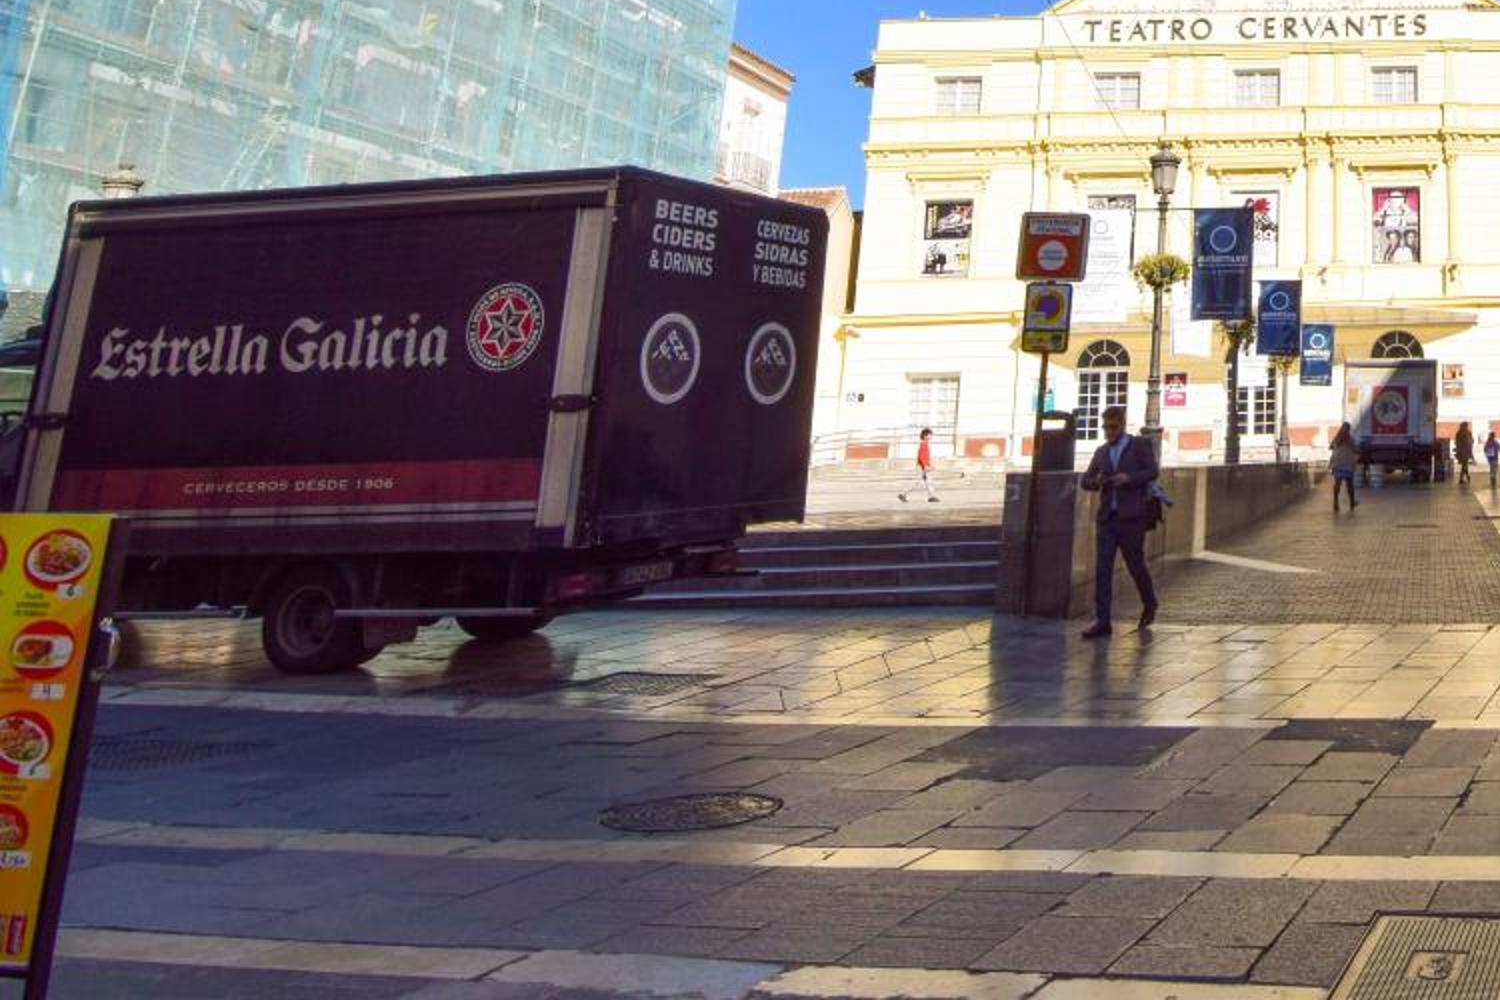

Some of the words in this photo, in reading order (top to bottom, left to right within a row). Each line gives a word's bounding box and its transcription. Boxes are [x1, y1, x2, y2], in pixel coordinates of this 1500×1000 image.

[1084, 17, 1213, 42] TEATRO
[1238, 14, 1427, 39] CERVANTES
[655, 200, 719, 228] BEERS
[652, 224, 716, 251] CIDERS
[757, 219, 810, 245] CERVEZAS
[649, 249, 659, 269] &
[663, 251, 713, 276] DRINKS
[754, 241, 808, 267] SIDRAS
[752, 264, 759, 282] Y
[761, 265, 806, 289] BEBIDAS
[88, 323, 267, 381] Estrella
[279, 312, 448, 373] Galicia
[183, 480, 289, 494] CERVECEROS
[295, 478, 348, 492] DESDE
[356, 477, 394, 490] 1906
